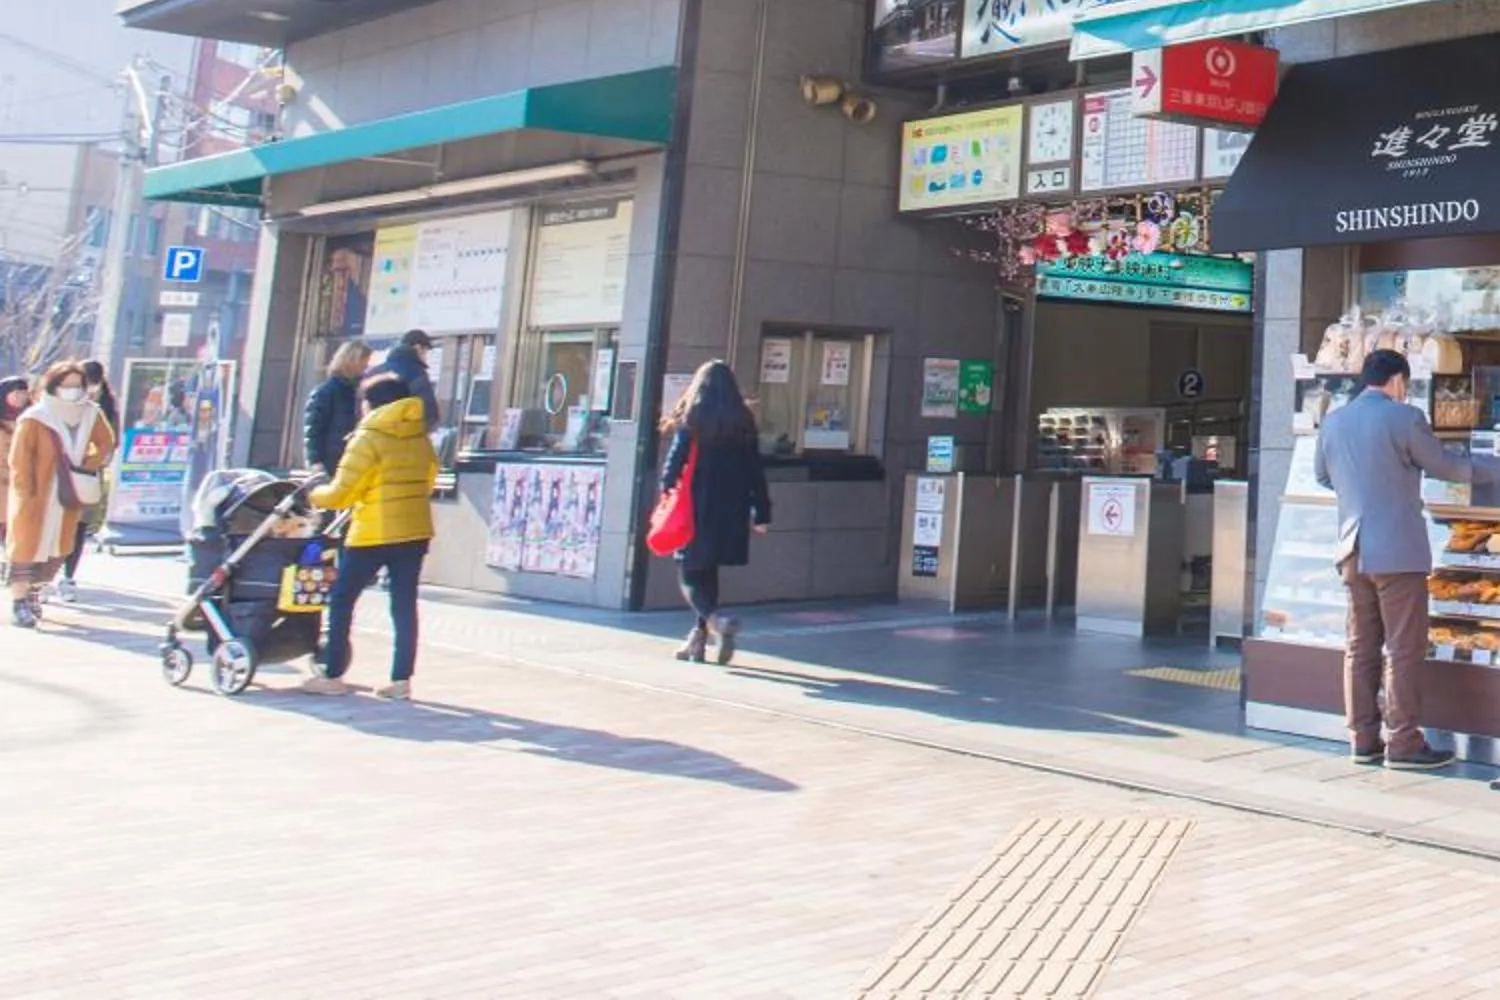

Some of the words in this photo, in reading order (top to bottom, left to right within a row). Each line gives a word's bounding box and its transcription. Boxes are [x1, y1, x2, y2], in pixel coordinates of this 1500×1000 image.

[1371, 113, 1498, 157] 進々堂
[1033, 171, 1065, 189] 入口
[1336, 199, 1480, 233] SHINSHINDO
[172, 250, 197, 277] P
[1182, 373, 1199, 396] 2
